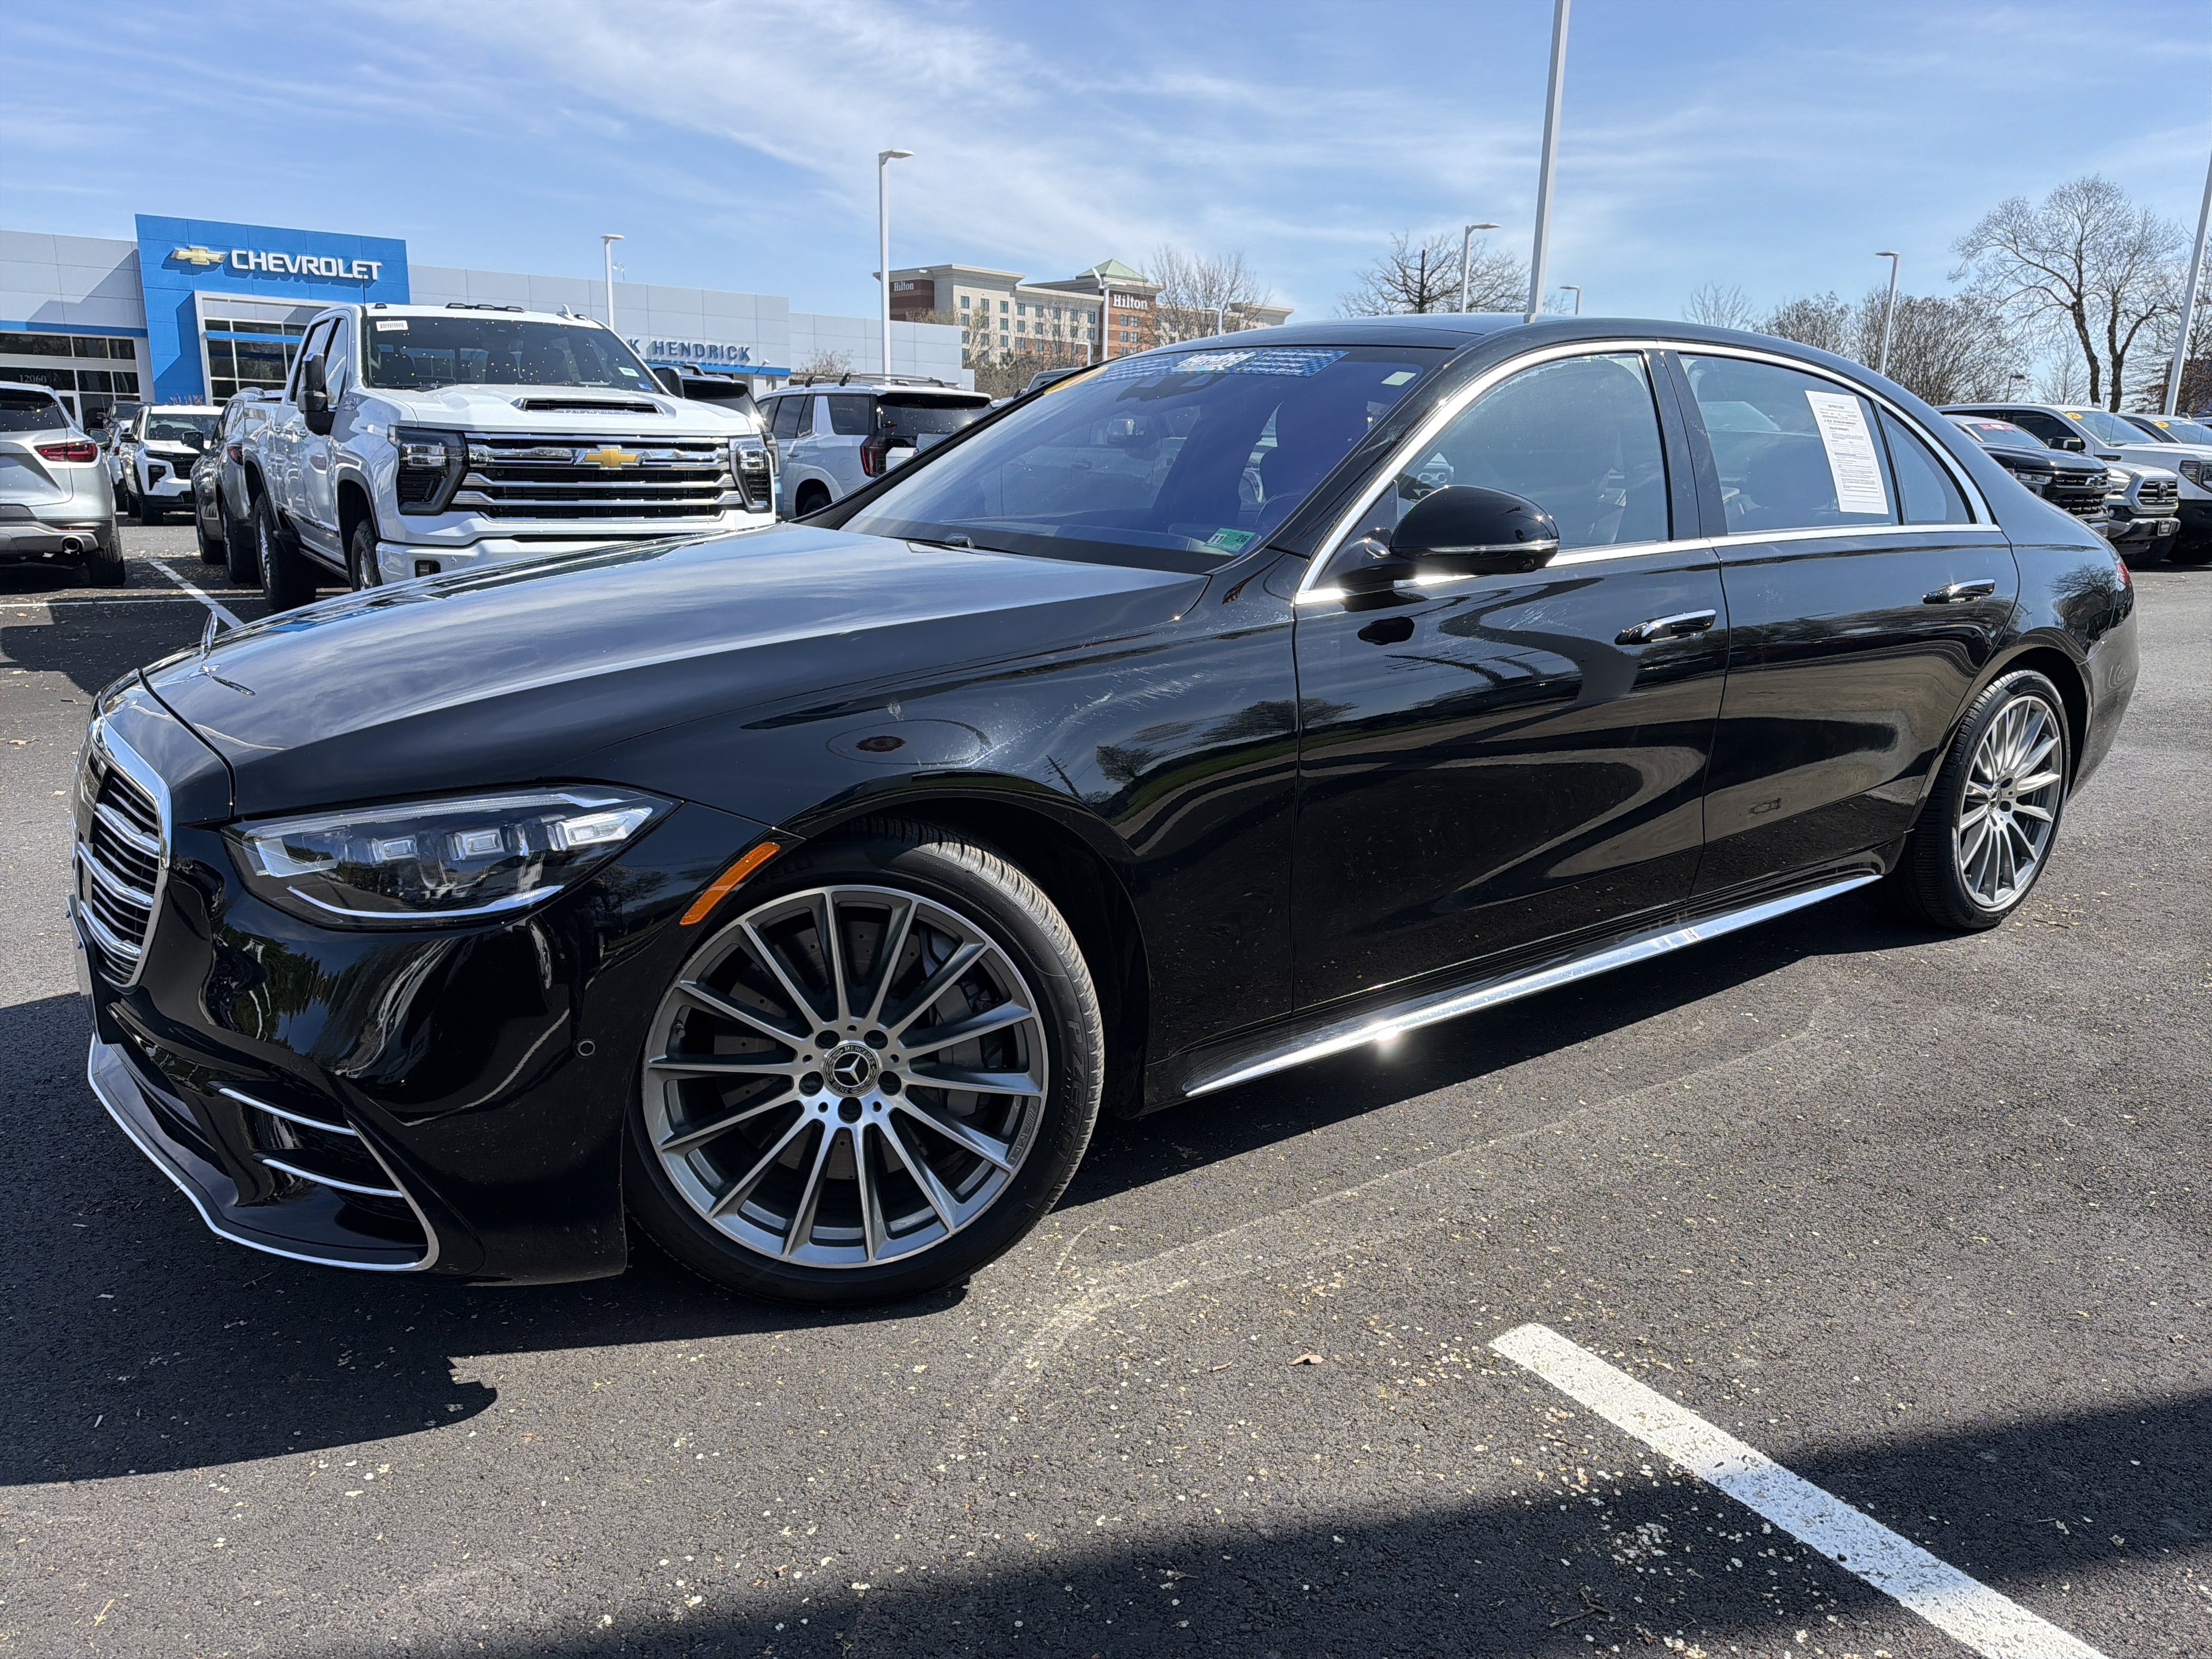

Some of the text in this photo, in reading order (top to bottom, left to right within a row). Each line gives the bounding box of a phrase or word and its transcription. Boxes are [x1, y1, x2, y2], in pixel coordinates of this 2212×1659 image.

[231, 249, 382, 280] CHEVROLET
[894, 280, 915, 291] Hilton
[1113, 294, 1148, 311] Hilton
[653, 340, 751, 361] HENDRICK
[19, 374, 47, 383] 12060
[1211, 534, 1249, 544] 11 26
[844, 1046, 876, 1066] MERCEDES
[831, 1081, 850, 1093] BENZ
